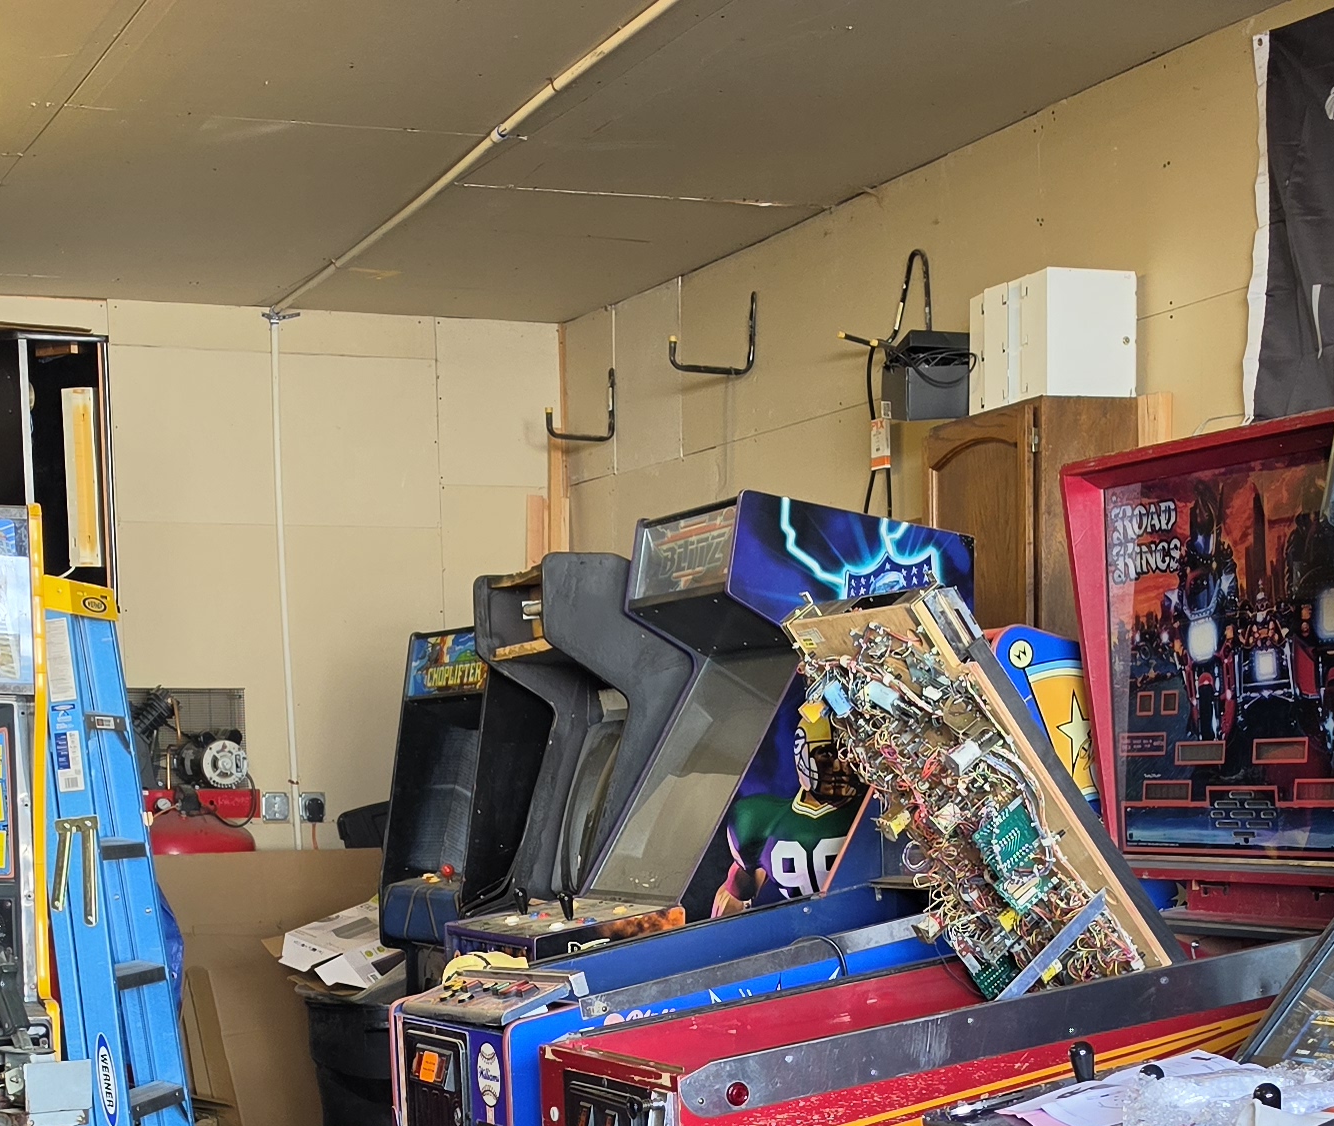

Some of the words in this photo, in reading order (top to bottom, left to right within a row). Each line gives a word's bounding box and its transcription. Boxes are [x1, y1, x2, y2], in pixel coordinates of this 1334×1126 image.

[1111, 500, 1176, 544] ROAD
[1112, 538, 1181, 583] KINGS
[426, 661, 482, 687] CHOPLIFTER
[100, 1053, 114, 1108] WERNER
[478, 1066, 500, 1083] Williams
